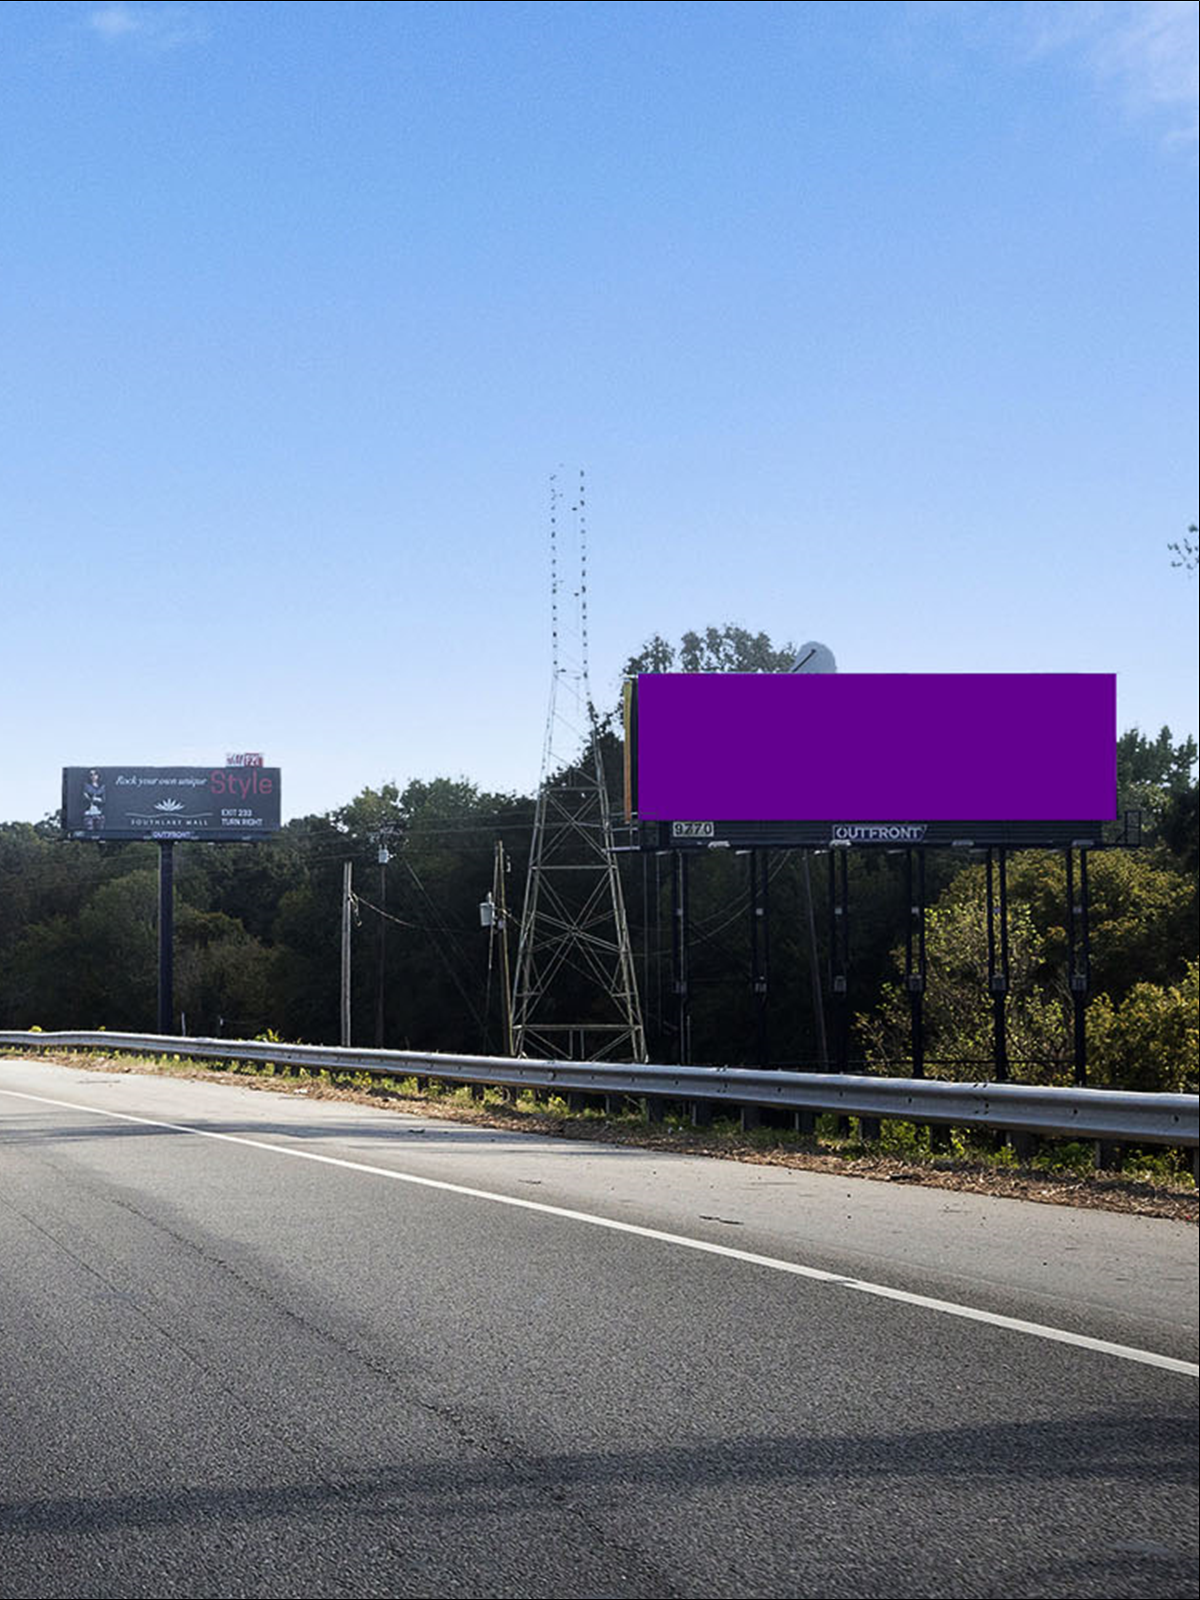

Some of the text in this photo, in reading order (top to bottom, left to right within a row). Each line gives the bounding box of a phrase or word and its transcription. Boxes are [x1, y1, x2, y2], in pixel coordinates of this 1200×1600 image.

[115, 775, 136, 786] Rock
[137, 778, 158, 788] your
[178, 775, 207, 788] unique
[211, 769, 272, 800] Style
[221, 808, 237, 817] EXIT
[221, 818, 263, 826] TURN RIGHT
[674, 823, 713, 835] 9770
[836, 826, 920, 840] OUTFRONT
